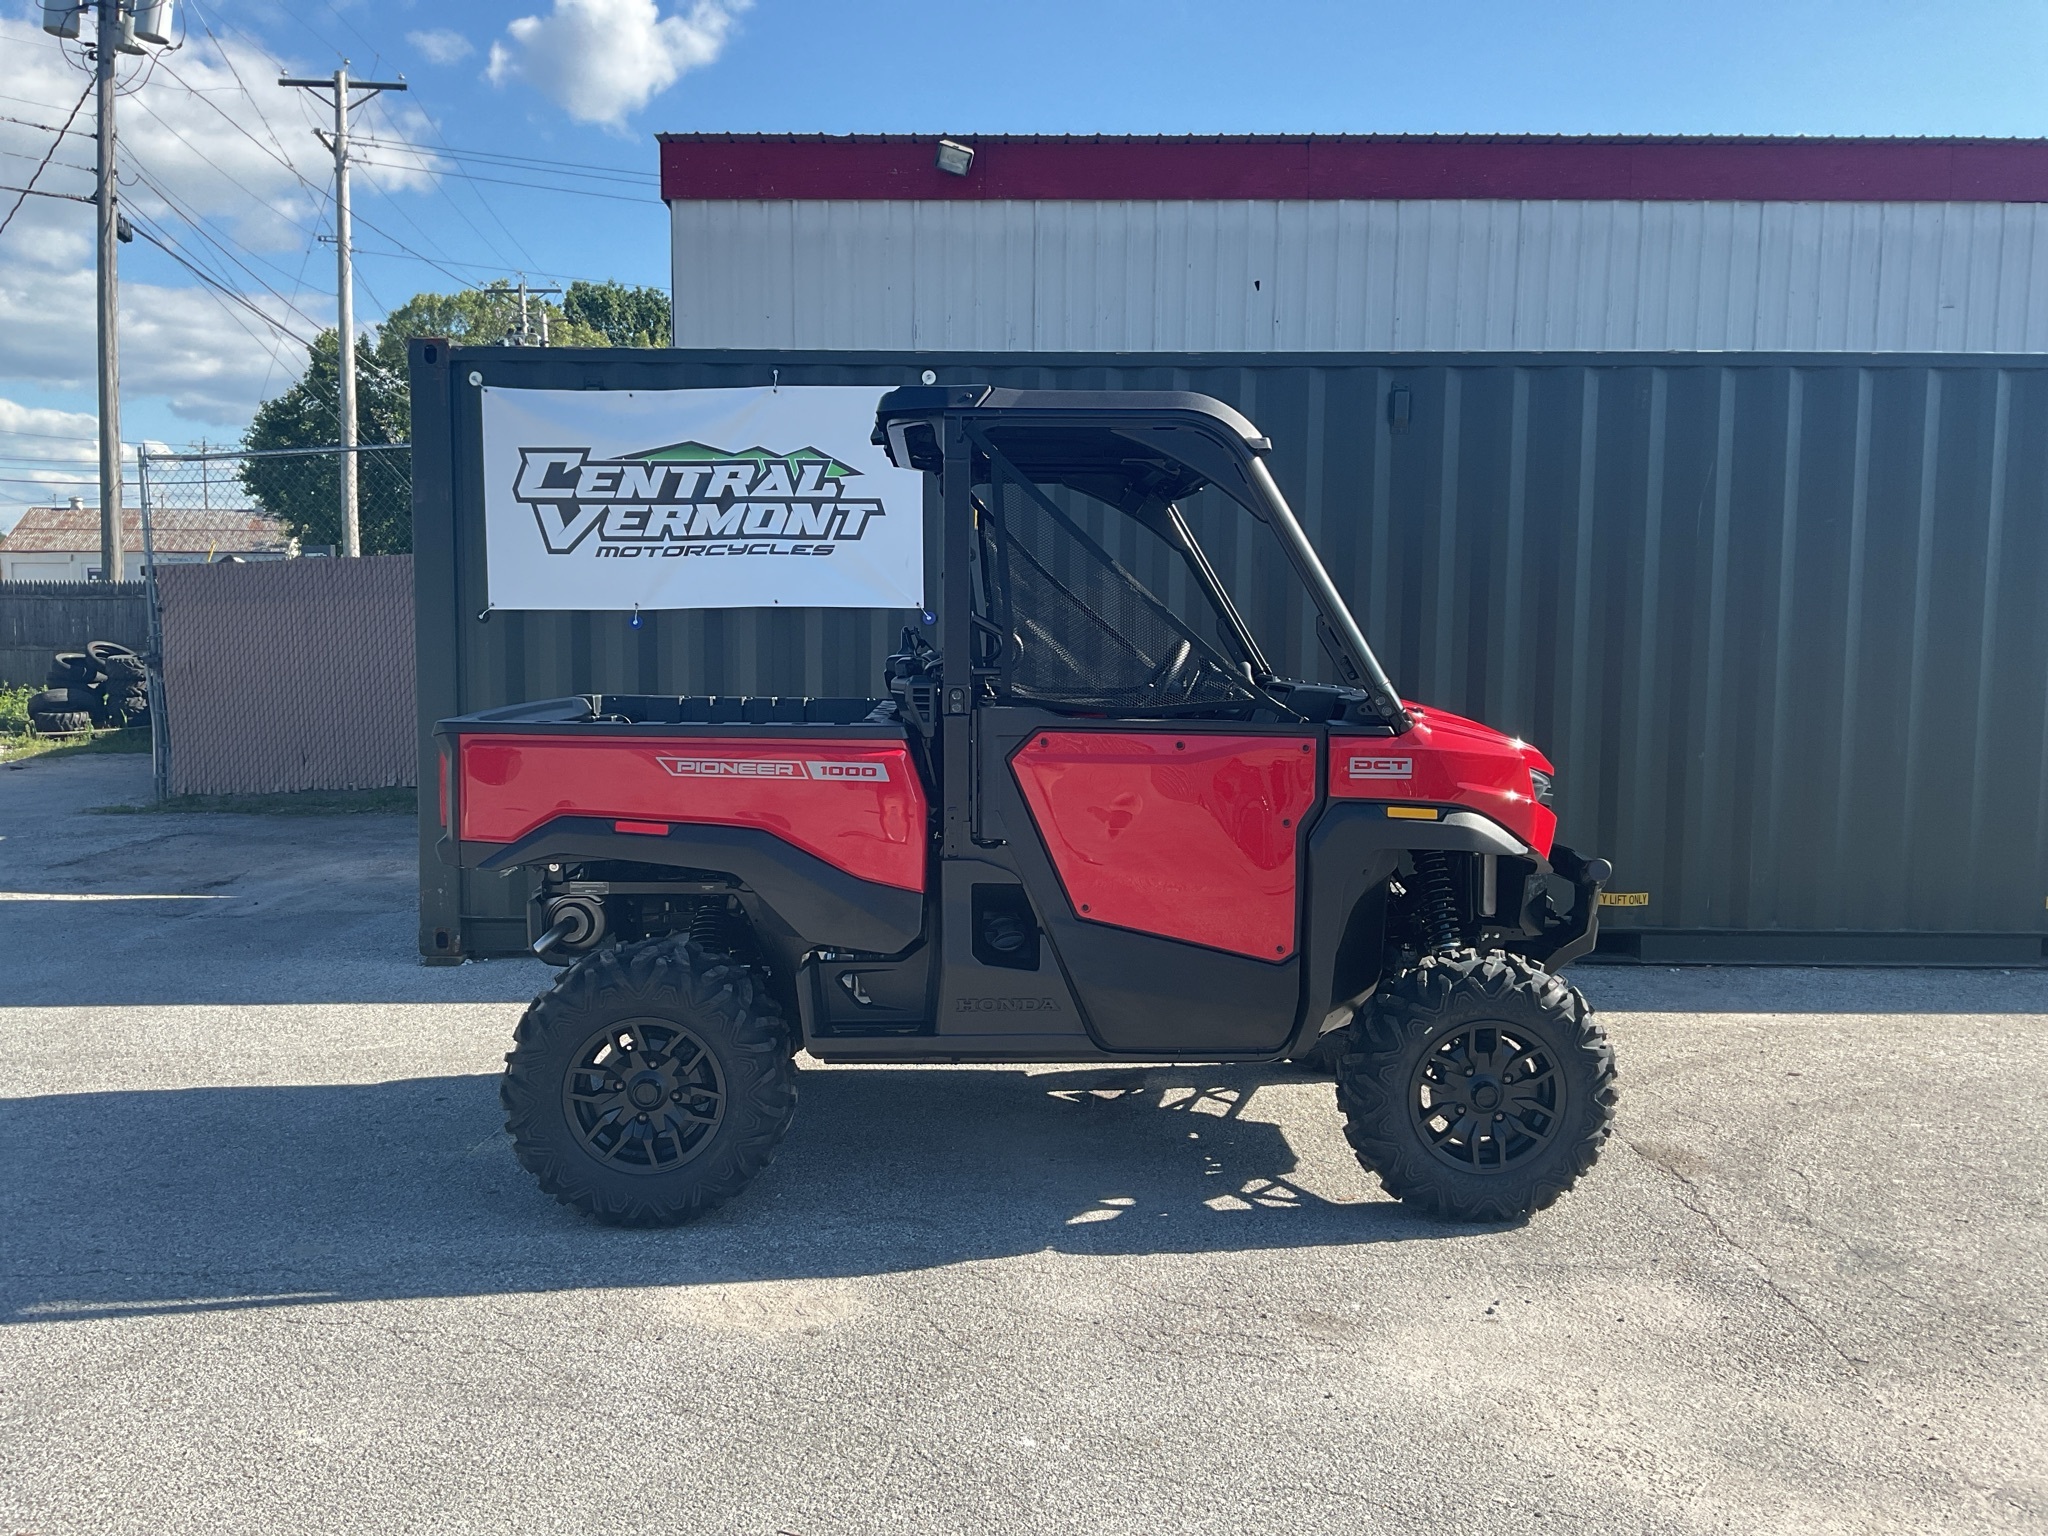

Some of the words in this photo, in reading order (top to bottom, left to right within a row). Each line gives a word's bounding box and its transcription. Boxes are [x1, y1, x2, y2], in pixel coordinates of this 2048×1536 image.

[514, 449, 842, 500] CENTRAL
[533, 501, 883, 552] VERMONT
[595, 543, 836, 558] MOTORCYCLES
[676, 761, 794, 776] PIONEER
[820, 765, 877, 777] 1000
[1354, 760, 1408, 770] DCT
[1609, 894, 1627, 905] LIFT
[1629, 894, 1647, 905] ONLY
[956, 998, 1061, 1012] HONDA
